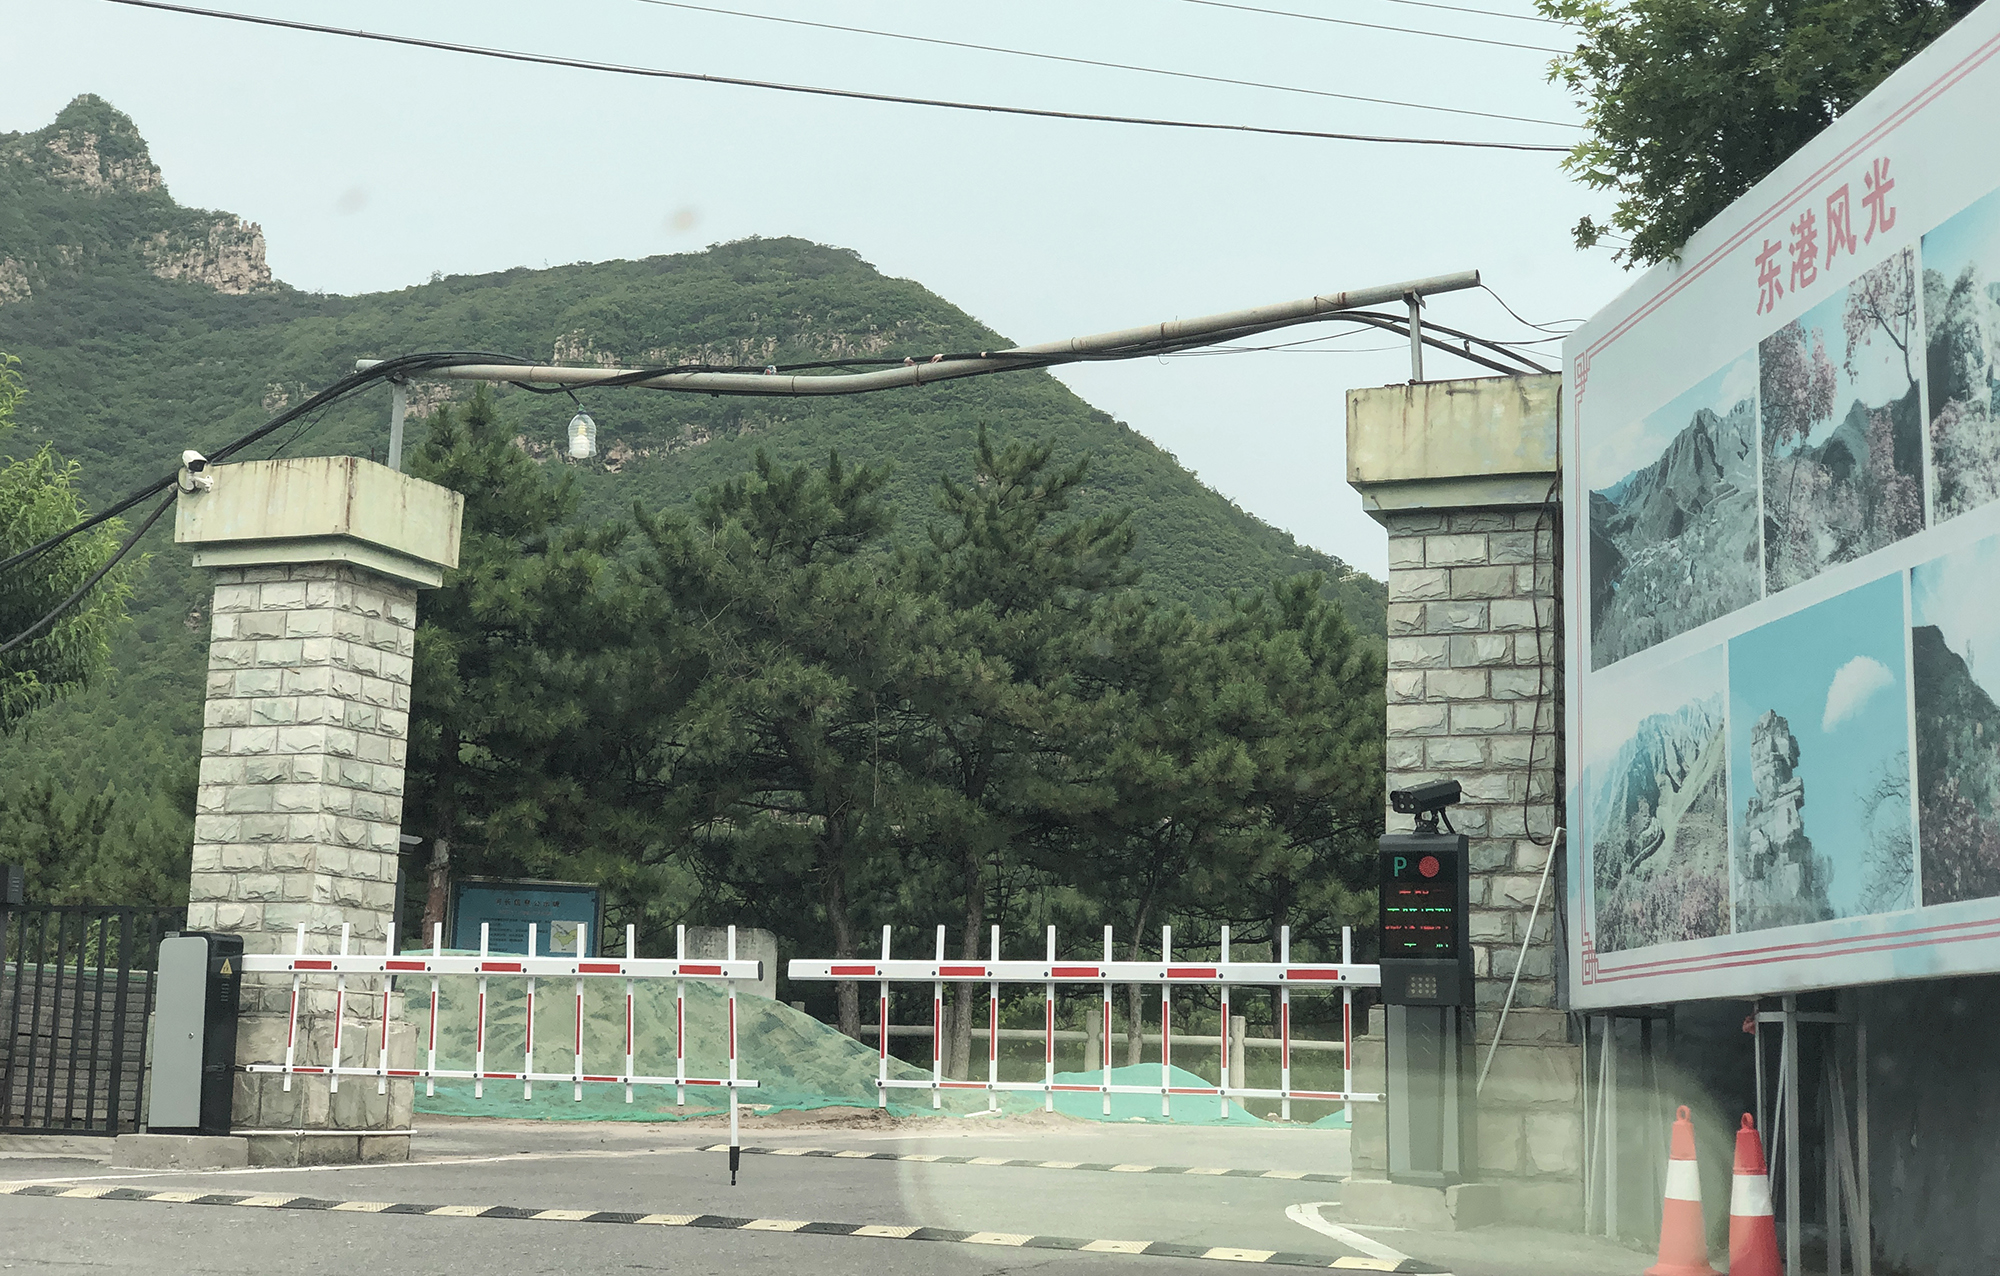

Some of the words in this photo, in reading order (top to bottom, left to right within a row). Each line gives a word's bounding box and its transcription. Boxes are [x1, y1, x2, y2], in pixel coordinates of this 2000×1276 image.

[1755, 156, 1896, 316] 东港风光
[1394, 856, 1407, 877] P
